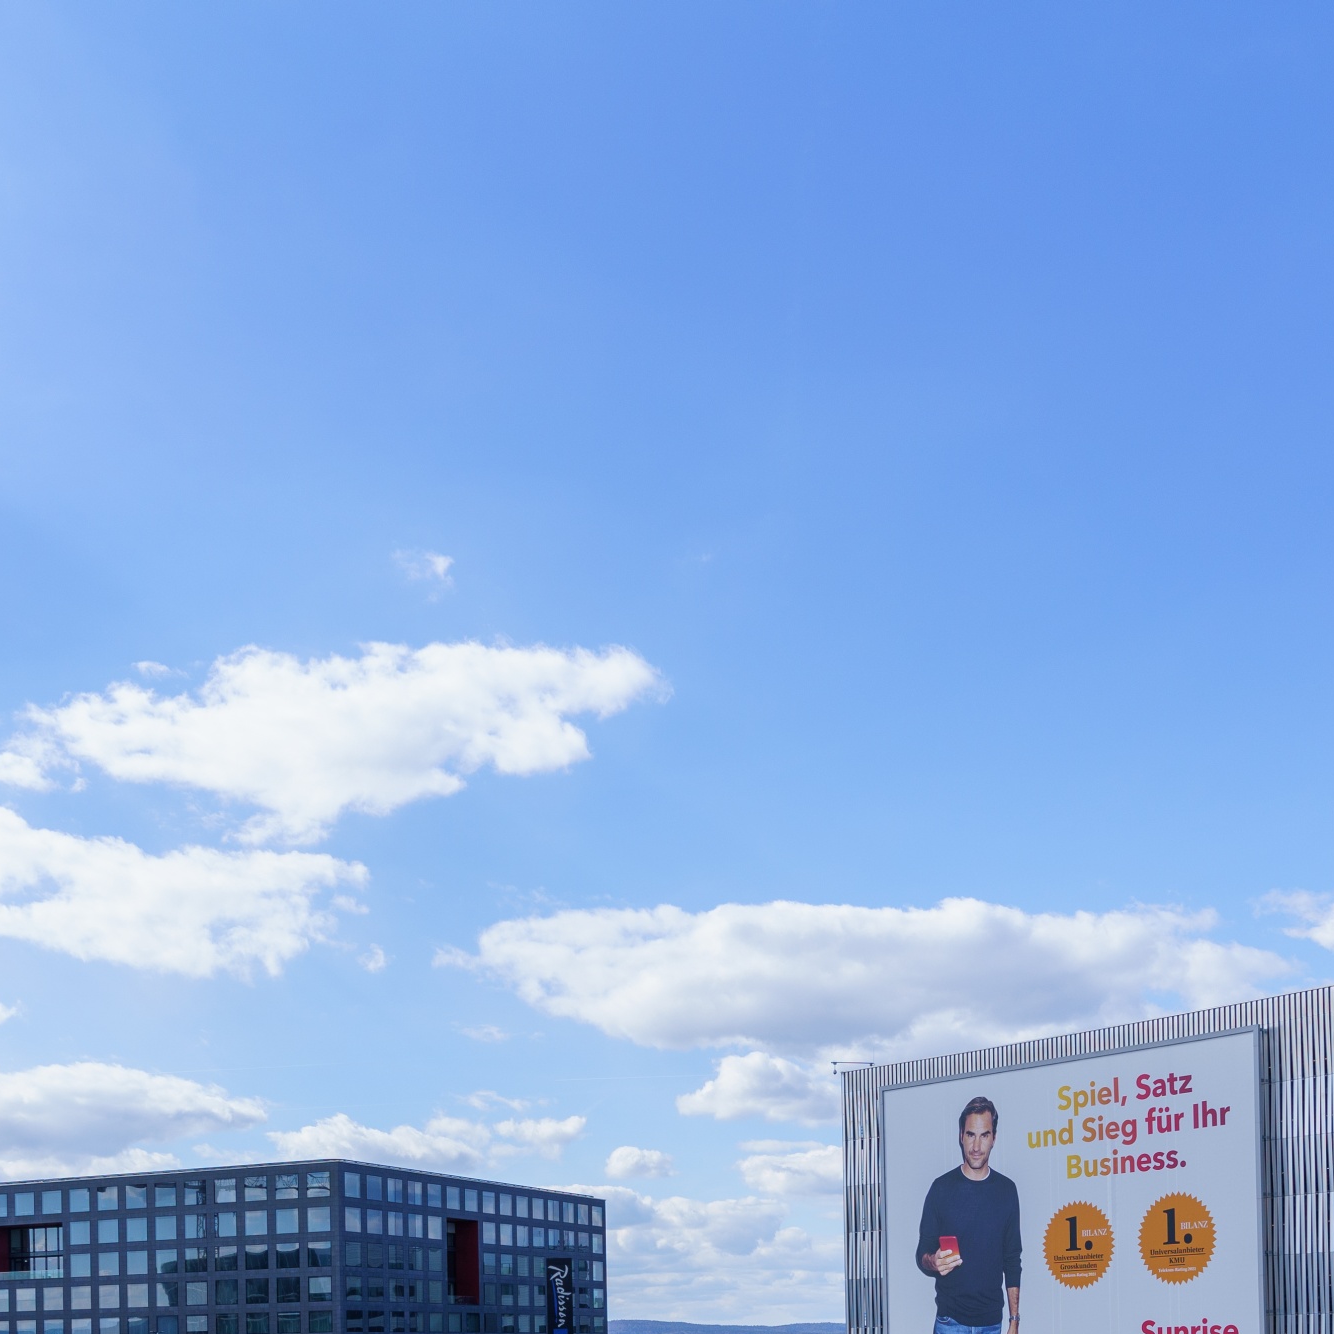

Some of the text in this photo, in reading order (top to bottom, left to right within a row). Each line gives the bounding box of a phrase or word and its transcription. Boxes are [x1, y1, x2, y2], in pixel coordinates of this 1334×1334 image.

[1057, 1072, 1193, 1116] Spiel, Satz
[1027, 1100, 1231, 1149] und Sieg für Ihr
[1067, 1149, 1187, 1179] Business.
[1180, 1221, 1208, 1230] BILANZ
[1082, 1228, 1107, 1237] BILANZ
[1150, 1247, 1205, 1256] Universalanbieter
[1053, 1253, 1104, 1261] Universalanbieter
[1060, 1262, 1097, 1270] Grosskunden
[548, 1264, 571, 1328] Radisson
